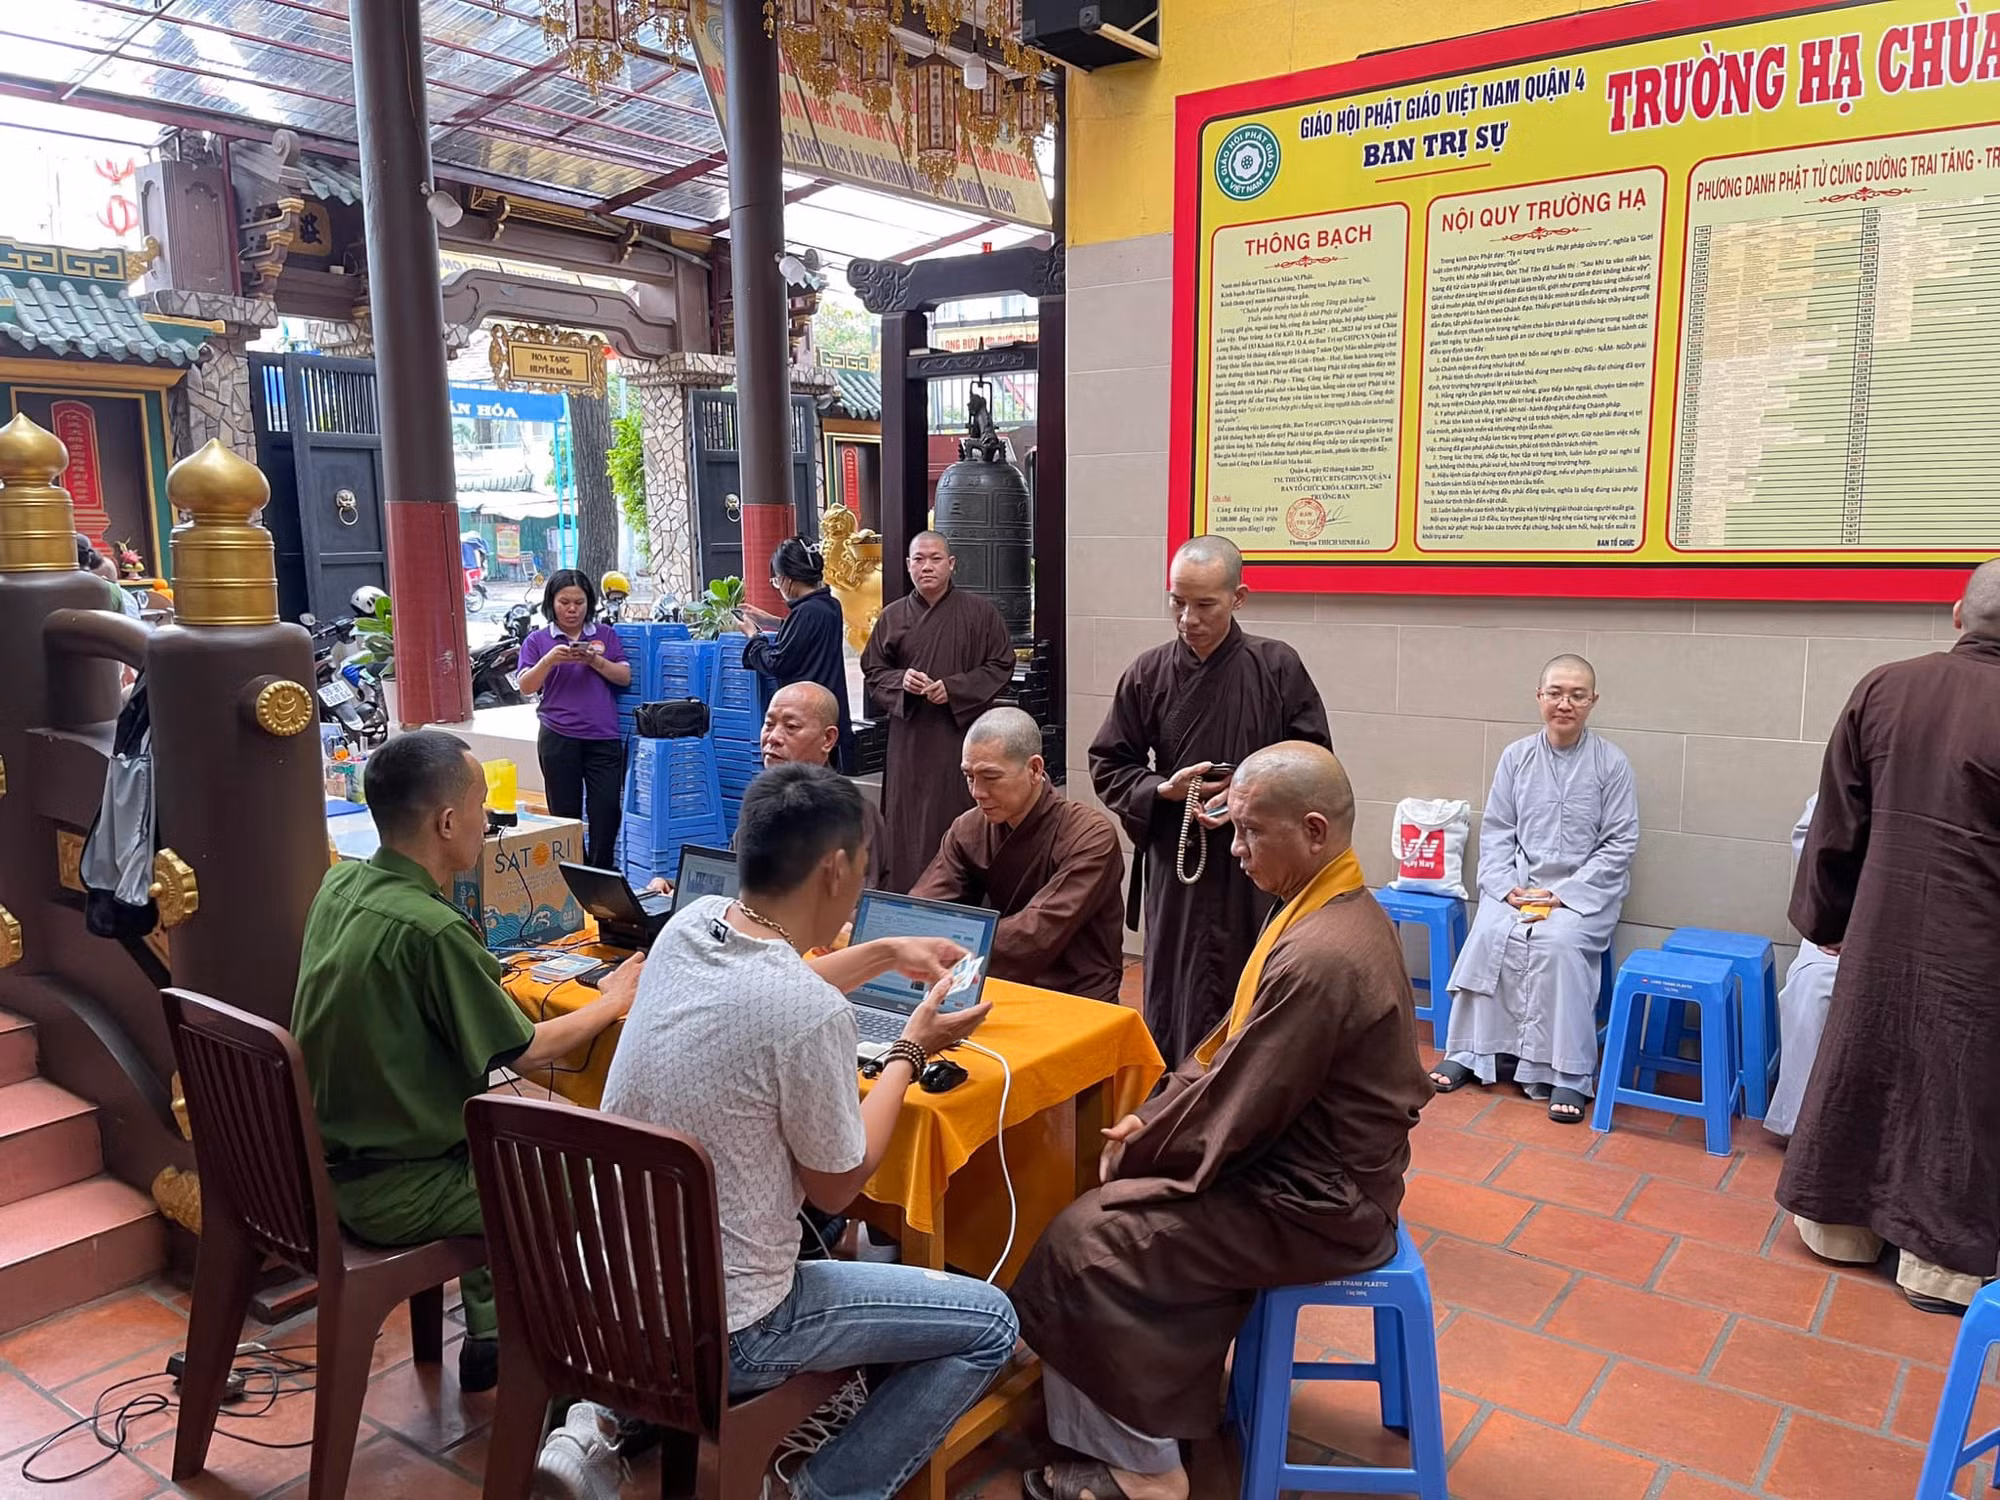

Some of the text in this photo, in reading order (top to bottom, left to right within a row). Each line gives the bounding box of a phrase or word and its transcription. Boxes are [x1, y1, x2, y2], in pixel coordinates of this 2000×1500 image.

[1608, 2, 2000, 132] TRƯỜNG HẠ CHÙA
[1300, 68, 1586, 139] GIÁO HỘI PHẬT GIÁO VIỆT NAM QUẬN 4
[1363, 121, 1509, 167] BAN TRỊ SỰ
[1246, 178, 1265, 193] NAM
[1697, 175, 1742, 202] PHƯƠNG
[1745, 171, 1777, 196] DANH
[1778, 164, 1809, 195] PHẬT
[1812, 158, 1828, 187] TỬ
[1830, 157, 1863, 186] CÚNG
[1865, 153, 1908, 182] DƯỜNG
[1911, 154, 1937, 177] TRAI
[1940, 145, 1974, 173] TĂNG
[1442, 187, 1647, 234] NỘI QUY TRƯỜNG HẠ
[1244, 224, 1372, 257] THÔNG BẠCH
[1480, 252, 1492, 260] Phật
[531, 352, 548, 362] HOA
[476, 402, 519, 418] HÓA
[495, 837, 571, 874] SATORI
